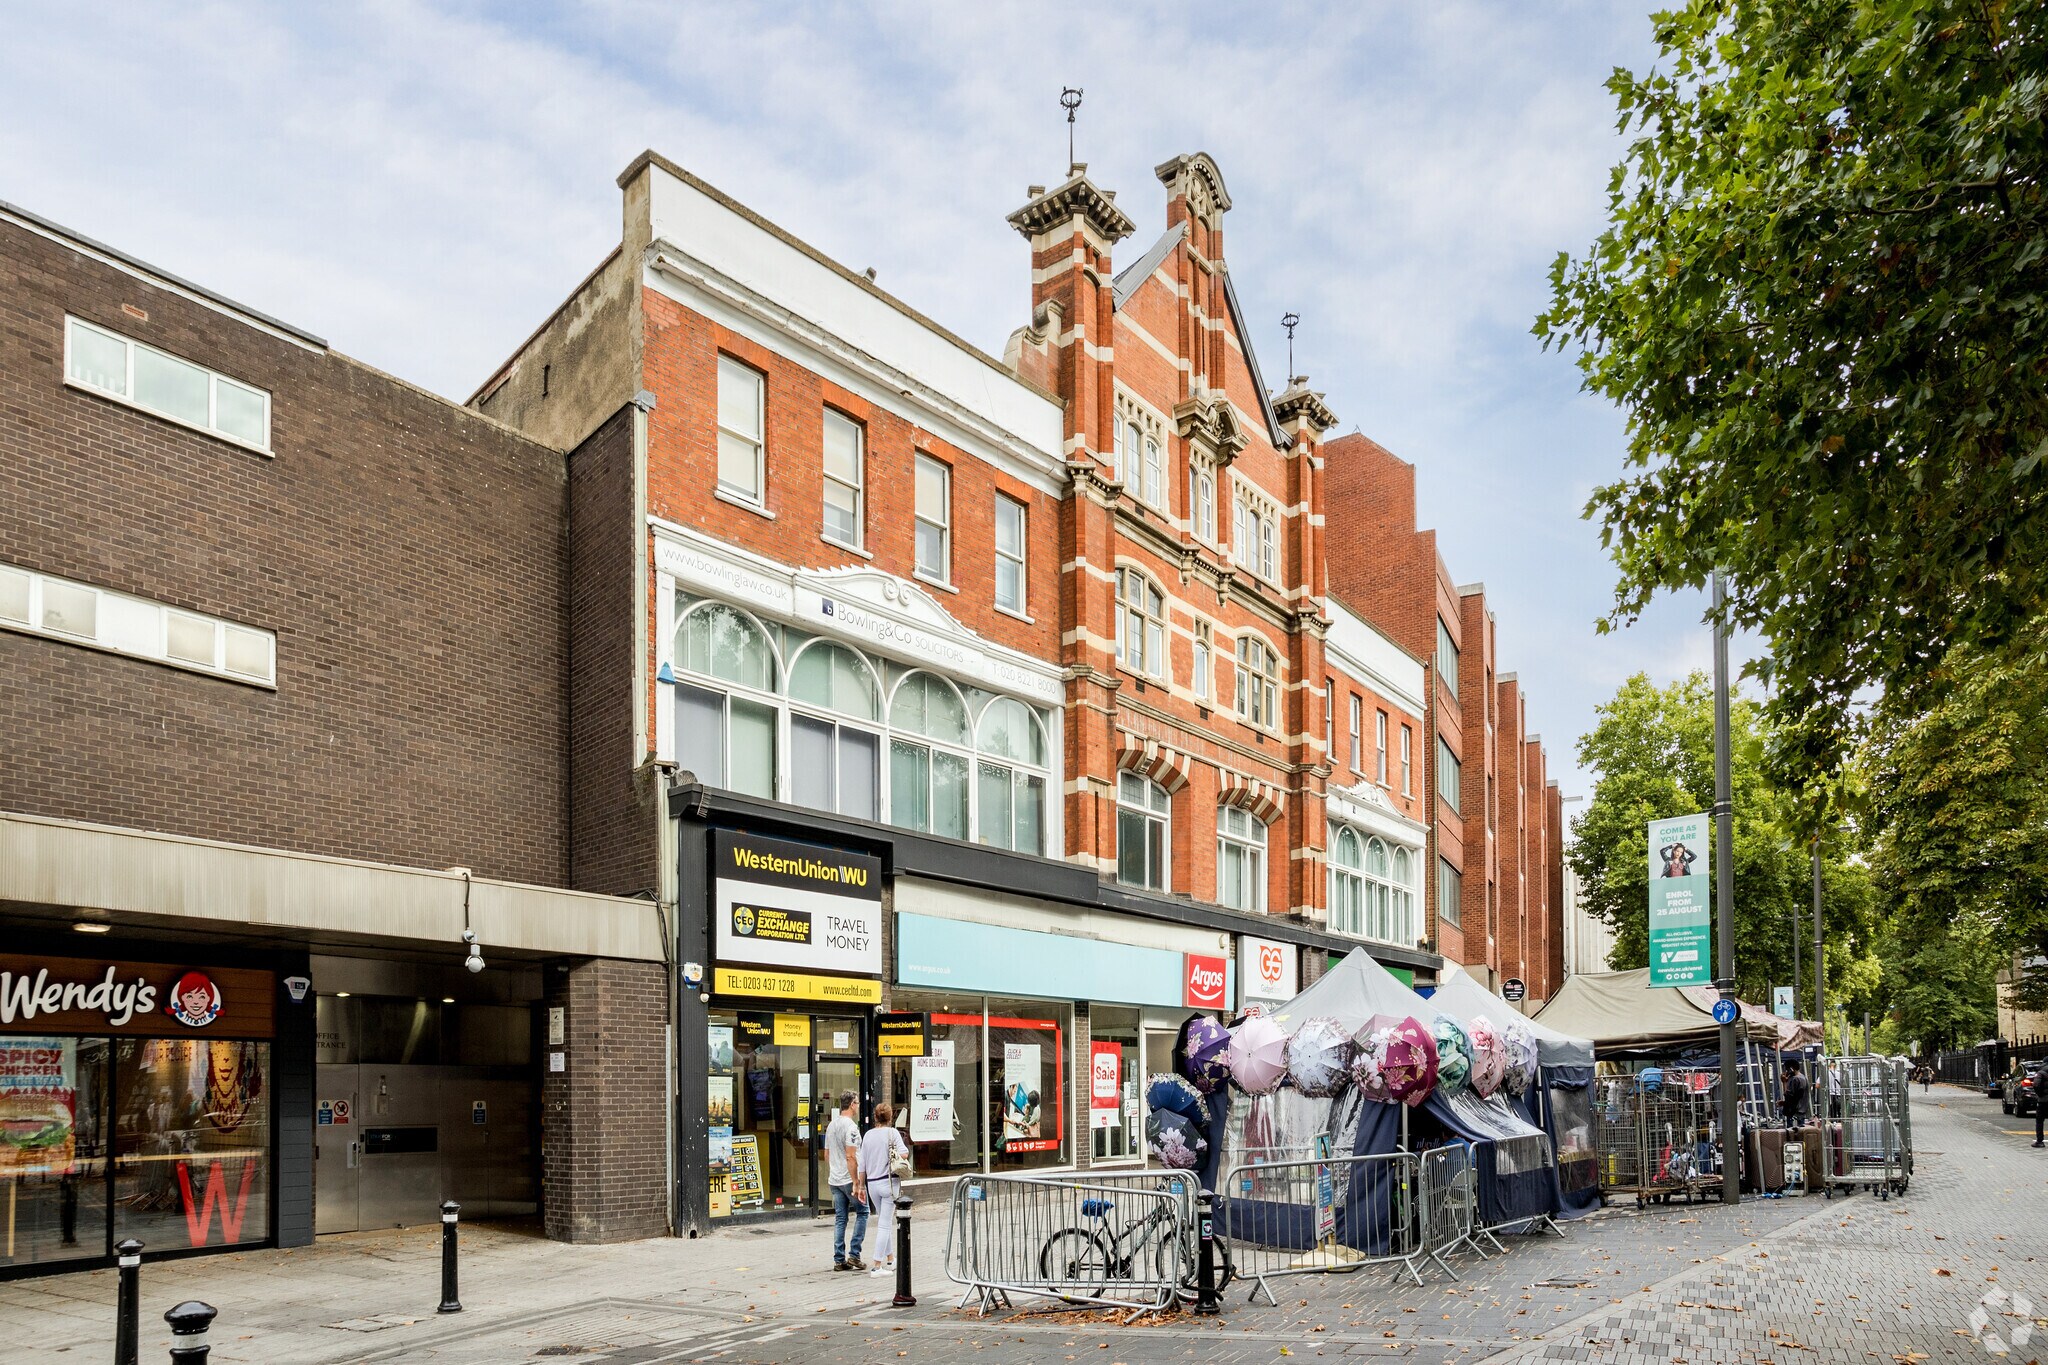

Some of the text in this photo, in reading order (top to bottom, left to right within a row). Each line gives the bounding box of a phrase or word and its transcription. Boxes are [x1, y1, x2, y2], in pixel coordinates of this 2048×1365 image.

[663, 547, 788, 602] www.bowlinglaw.co.uk
[838, 603, 912, 644] Bowling&Co
[915, 636, 964, 664] SOLICITORS
[1017, 672, 1035, 687] 8221
[1038, 679, 1056, 694] 8000
[1660, 824, 1697, 835] COME AS
[1660, 832, 1697, 843] YOU ARE
[1666, 890, 1693, 899] ENROL
[1667, 898, 1691, 907] FROM
[758, 909, 787, 920] CURRENCY
[1656, 905, 1703, 916] 25 AUGUST
[735, 915, 753, 926] CEC
[757, 917, 809, 934] EXCHANGE
[827, 916, 868, 935] TRAVEL
[756, 929, 806, 941] CORPORATION LTD.
[827, 934, 869, 951] MONEY
[727, 975, 795, 992] TEL: 0203 437 1228
[1190, 964, 1224, 991] Argos
[0, 966, 157, 1026] Wendy's
[823, 984, 872, 997] www.cecltd.com
[741, 1021, 761, 1029] Western
[747, 1027, 761, 1035] Union
[784, 1023, 801, 1031] Money
[166, 1046, 191, 1062] RECIPE
[934, 1048, 942, 1057] DAY
[917, 1059, 948, 1068] HOME DELIVERY
[1096, 1066, 1115, 1080] Sale
[176, 1159, 256, 1247] W
